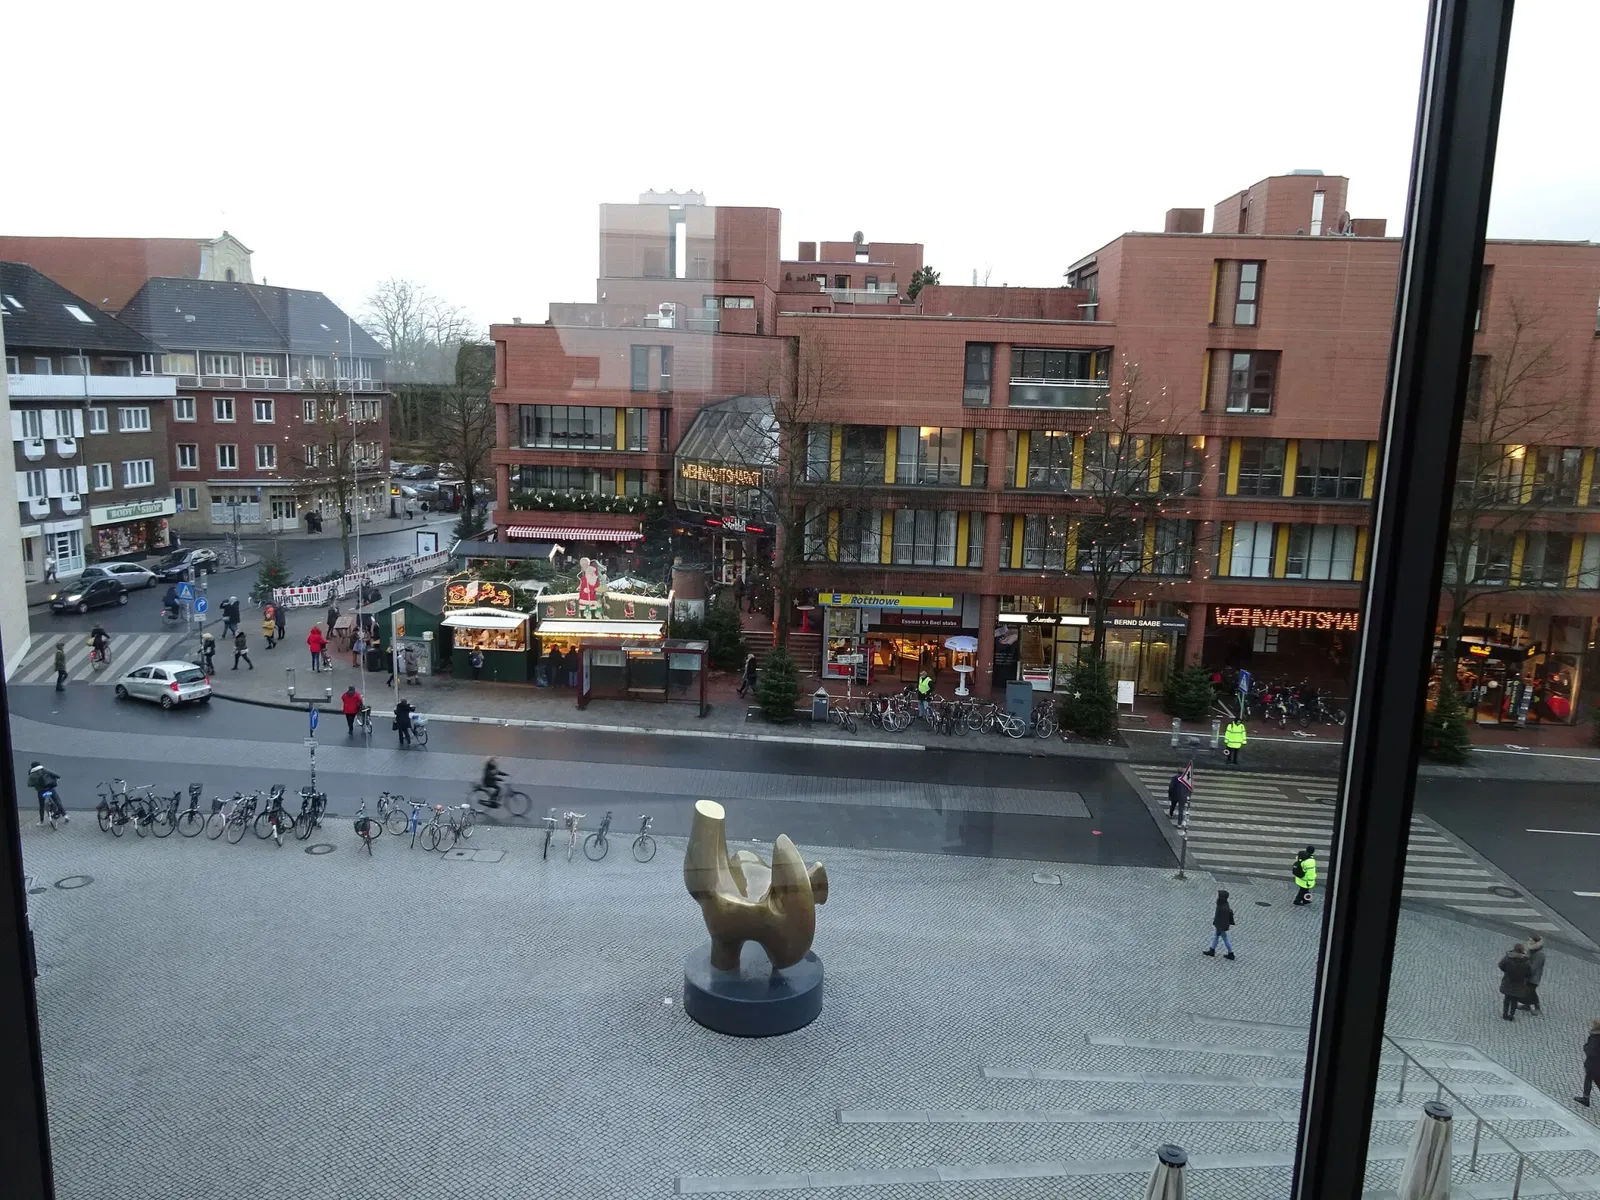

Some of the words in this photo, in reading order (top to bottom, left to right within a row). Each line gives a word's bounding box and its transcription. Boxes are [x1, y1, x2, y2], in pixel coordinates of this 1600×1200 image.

[681, 463, 762, 487] WEIHNACHTSMARKT
[111, 507, 133, 518] BODY
[141, 504, 161, 514] SHOP
[850, 596, 899, 605] Rotthowe
